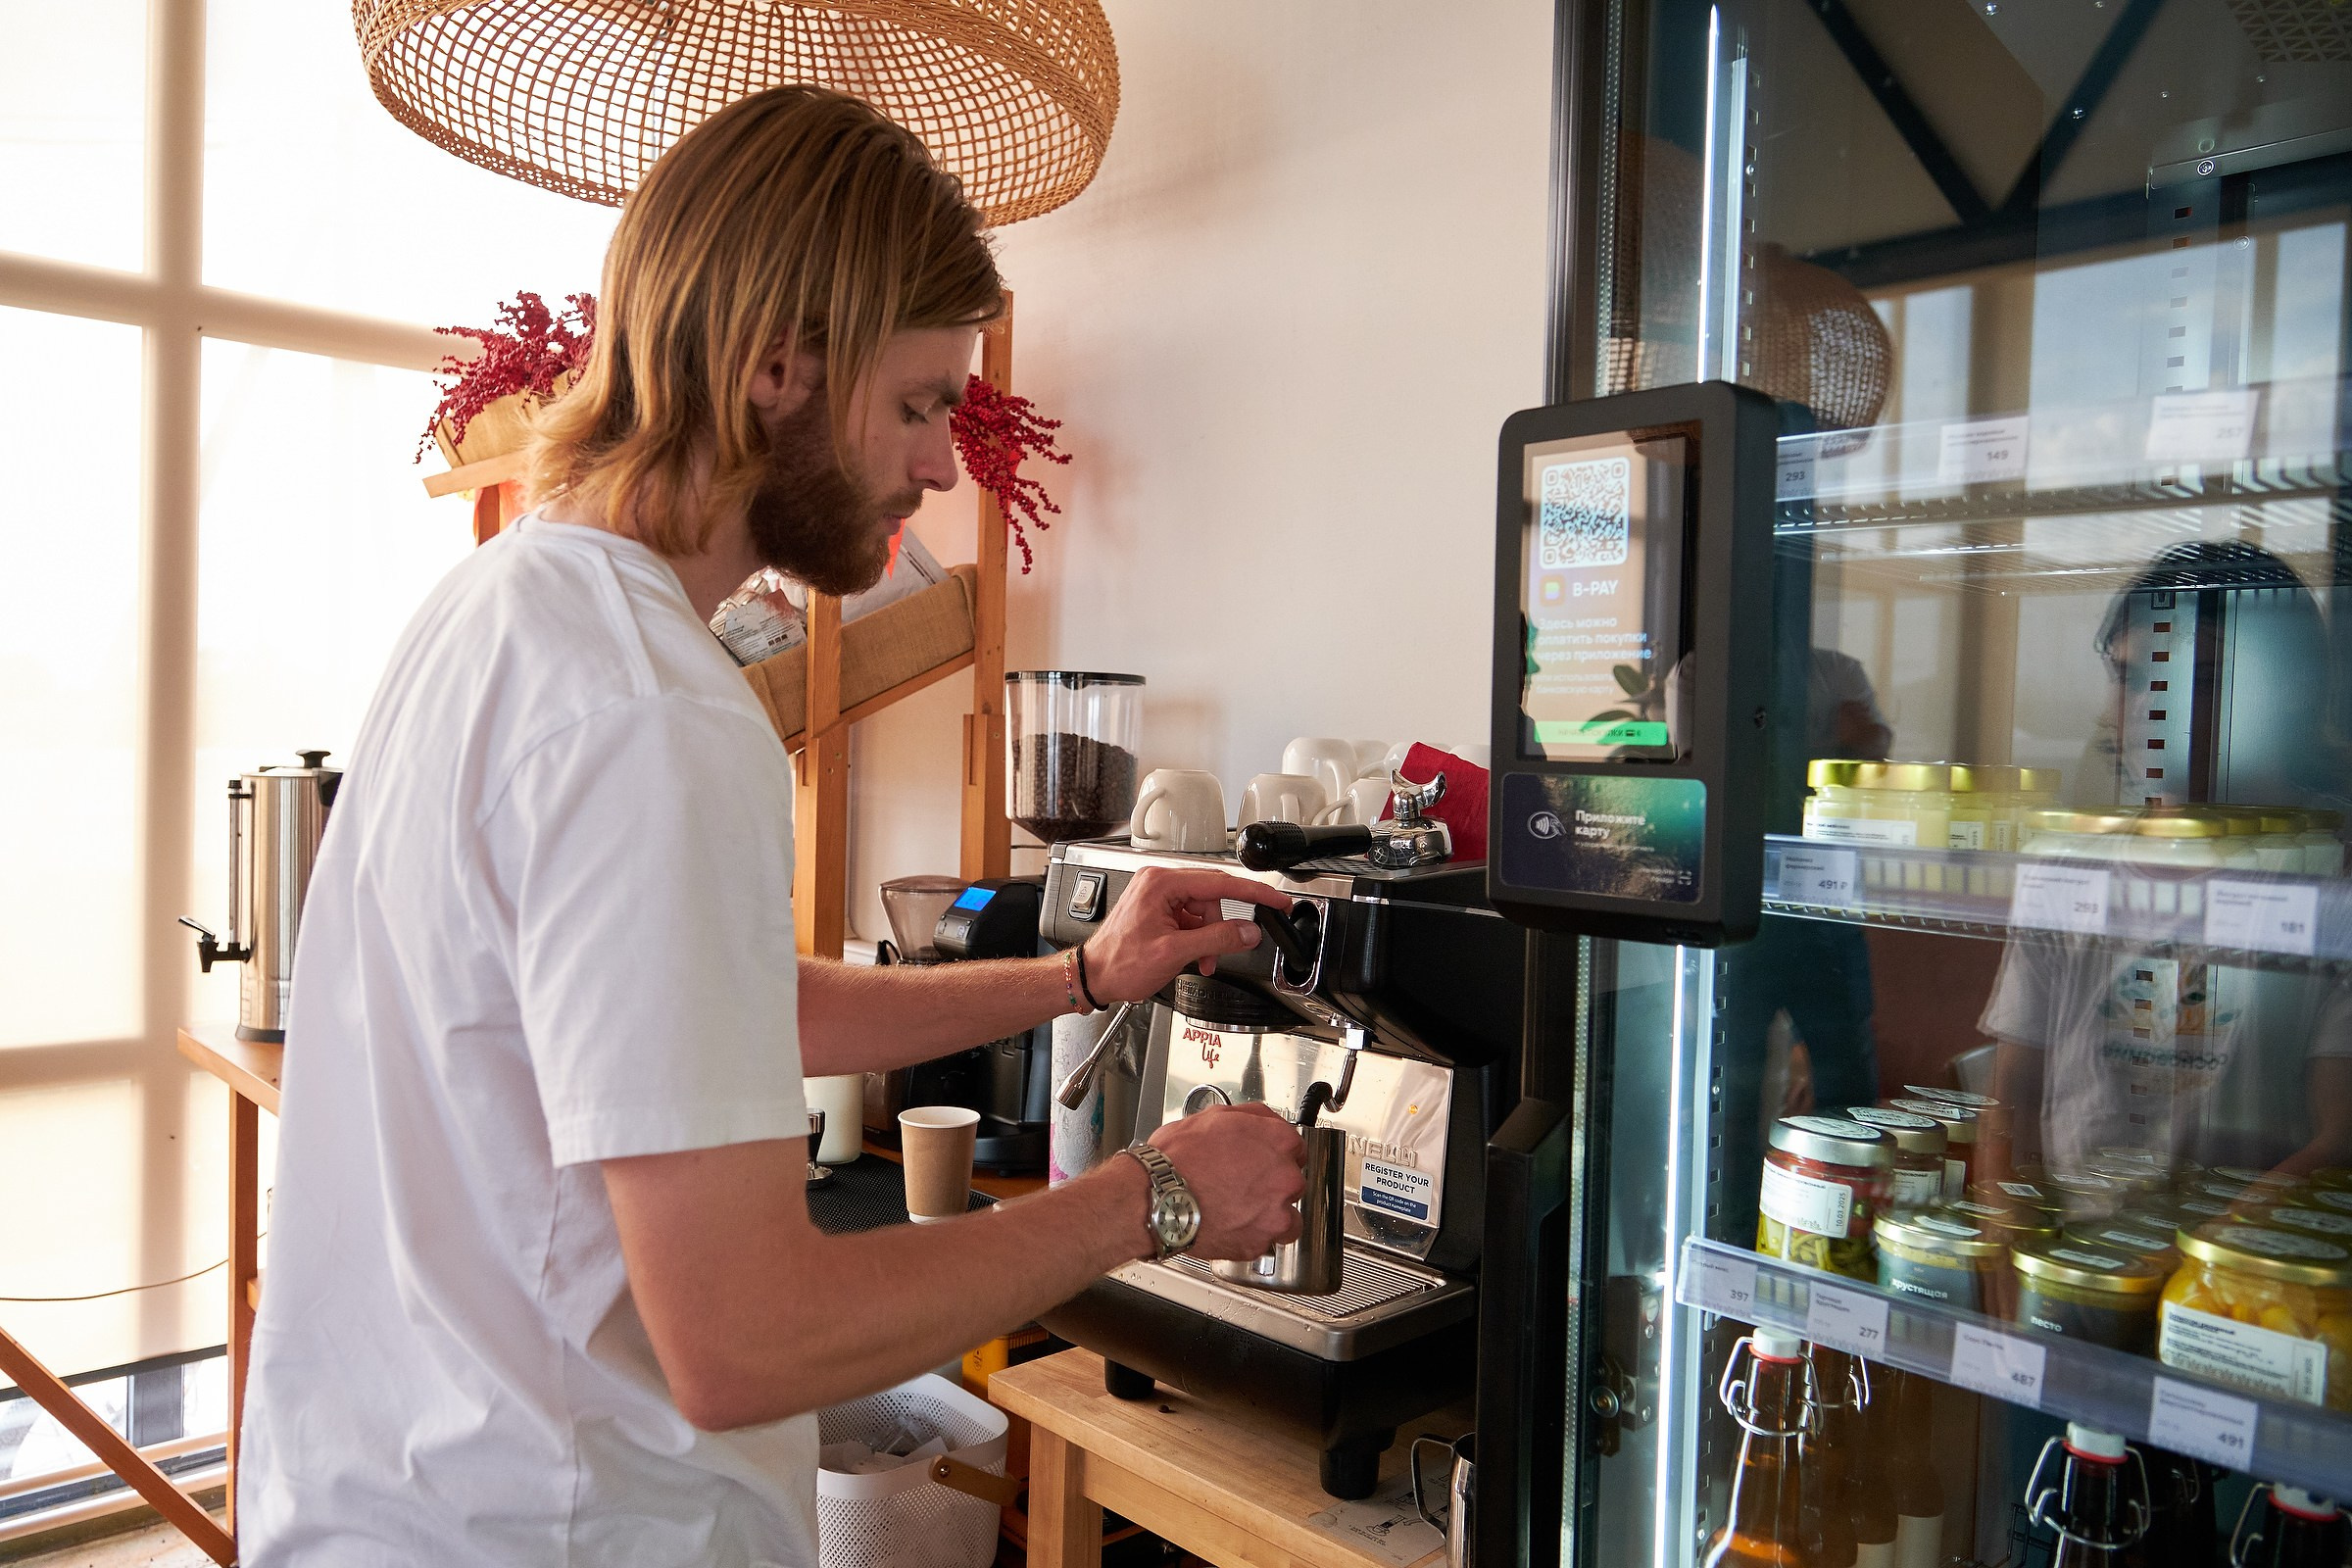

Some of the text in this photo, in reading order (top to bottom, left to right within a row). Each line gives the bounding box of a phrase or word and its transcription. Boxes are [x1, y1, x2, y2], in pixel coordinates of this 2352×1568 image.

[1986, 450, 2009, 462] 149
[1785, 470, 1805, 482] 293
[1573, 579, 1618, 597] B-PAY
[1540, 617, 1617, 630] Здесь можно
[1539, 632, 1647, 647] оплатить покупки
[1538, 648, 1652, 663] через приложение
[1575, 809, 1646, 826] Приложите
[1575, 826, 1611, 840] карту
[1818, 879, 1838, 891] 491
[1183, 1028, 1222, 1048] APPIA
[1365, 1162, 1430, 1187] REGISTER YOUR
[1377, 1177, 1415, 1194] PRODUCT
[1730, 1289, 1749, 1301] 397
[2030, 1315, 2063, 1333] песто
[1859, 1326, 1879, 1340] 277
